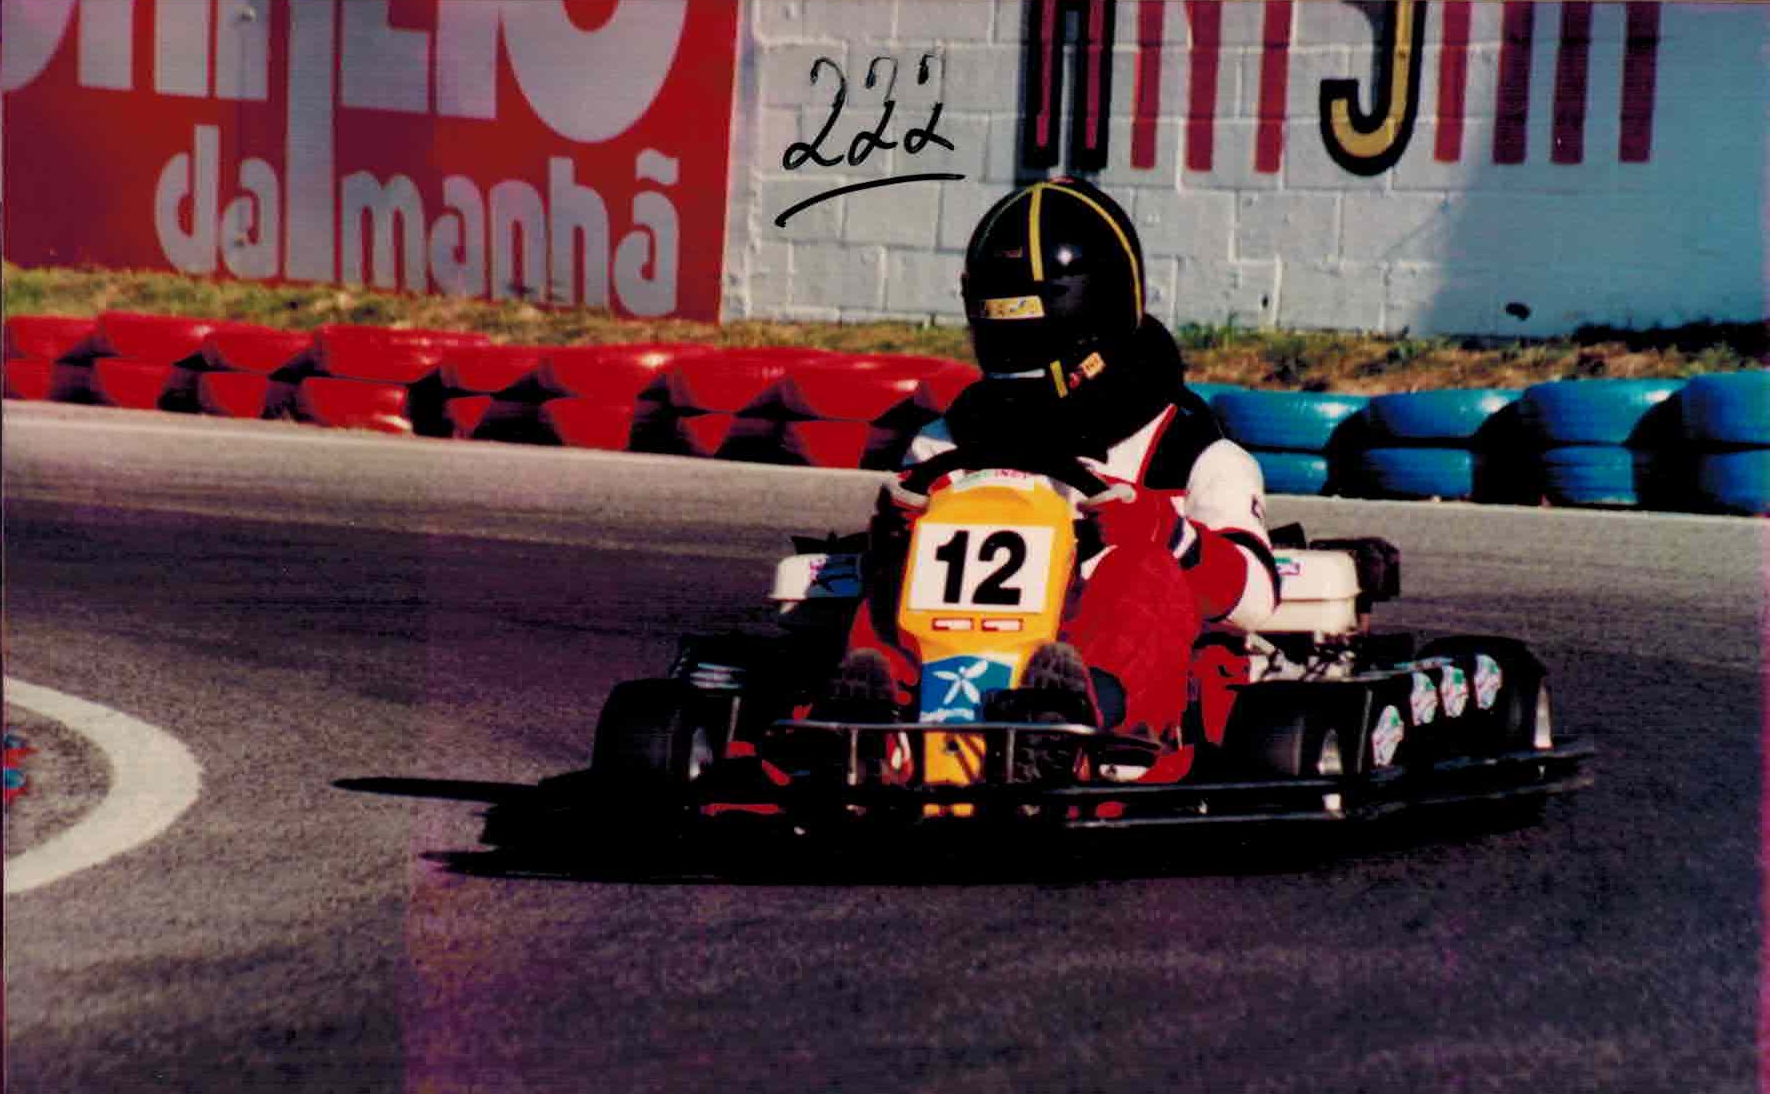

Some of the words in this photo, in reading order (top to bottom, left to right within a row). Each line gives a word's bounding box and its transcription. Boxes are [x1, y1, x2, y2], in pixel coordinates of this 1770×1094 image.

[783, 54, 955, 170] 222
[155, 124, 280, 280] da
[341, 149, 679, 318] manhã
[935, 529, 1027, 606] 12
